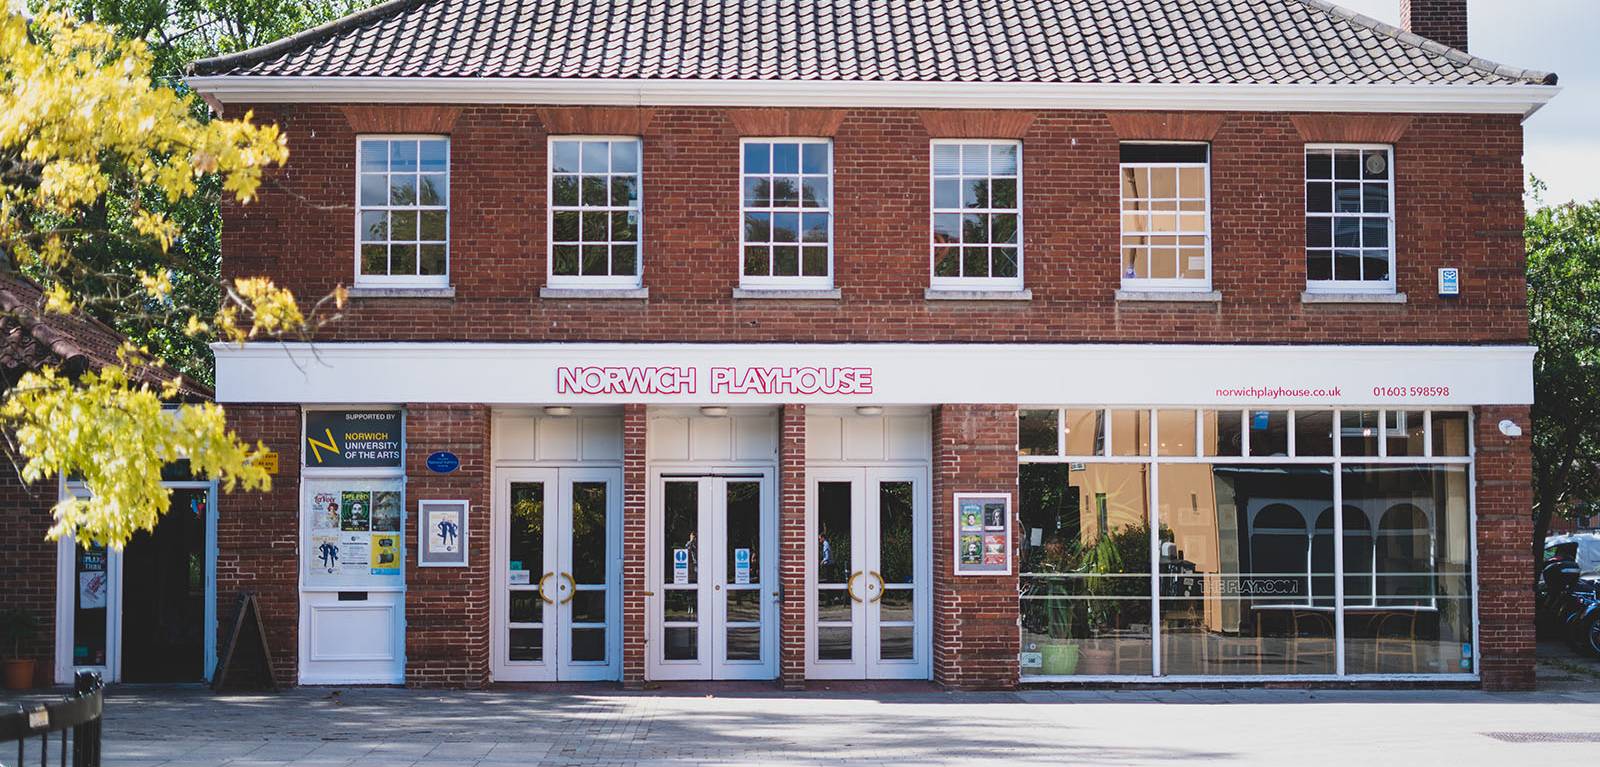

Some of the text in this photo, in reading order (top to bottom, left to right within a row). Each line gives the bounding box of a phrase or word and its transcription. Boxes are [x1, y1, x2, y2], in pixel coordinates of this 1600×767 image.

[557, 367, 872, 394] NORWICH PLAYHOUSE
[1215, 386, 1450, 399] norwichplayhouse.co.uk 01603 598598
[345, 442, 398, 450] UNIVERSITY
[345, 451, 400, 459] OF THE ARTS
[1228, 580, 1299, 593] PLAYROOM
